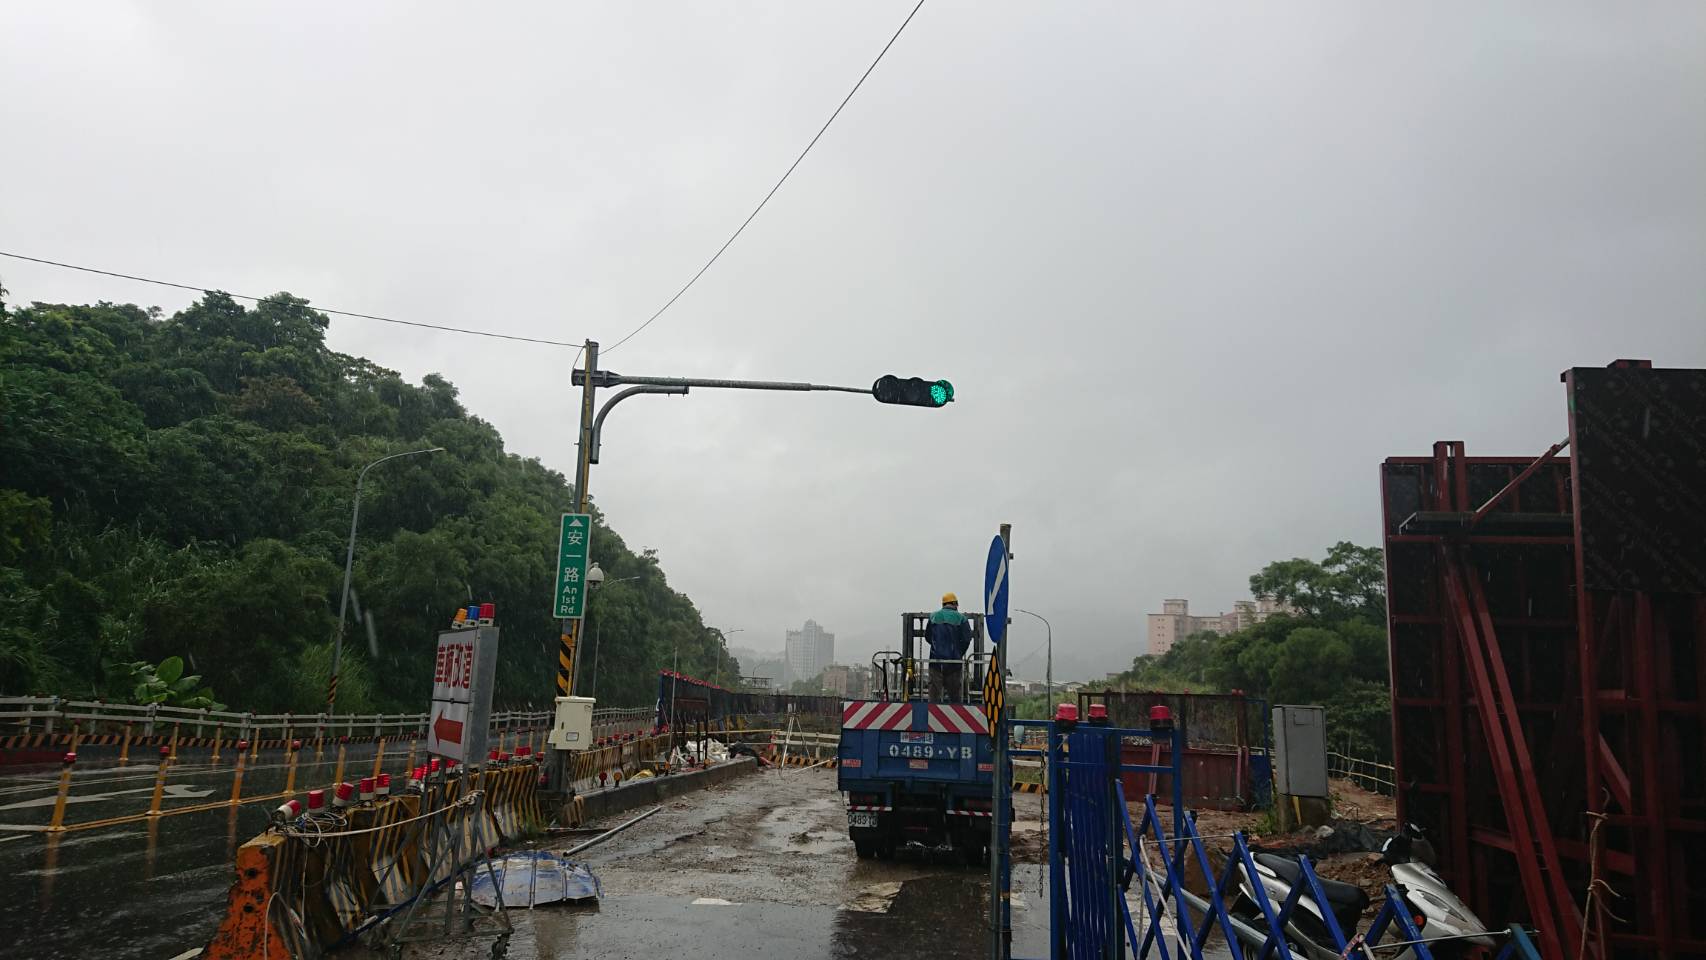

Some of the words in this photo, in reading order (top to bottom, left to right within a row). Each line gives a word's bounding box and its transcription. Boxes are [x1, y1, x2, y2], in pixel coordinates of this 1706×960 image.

[564, 530, 583, 582] 安一路
[562, 585, 577, 594] An
[562, 596, 576, 604] 1st
